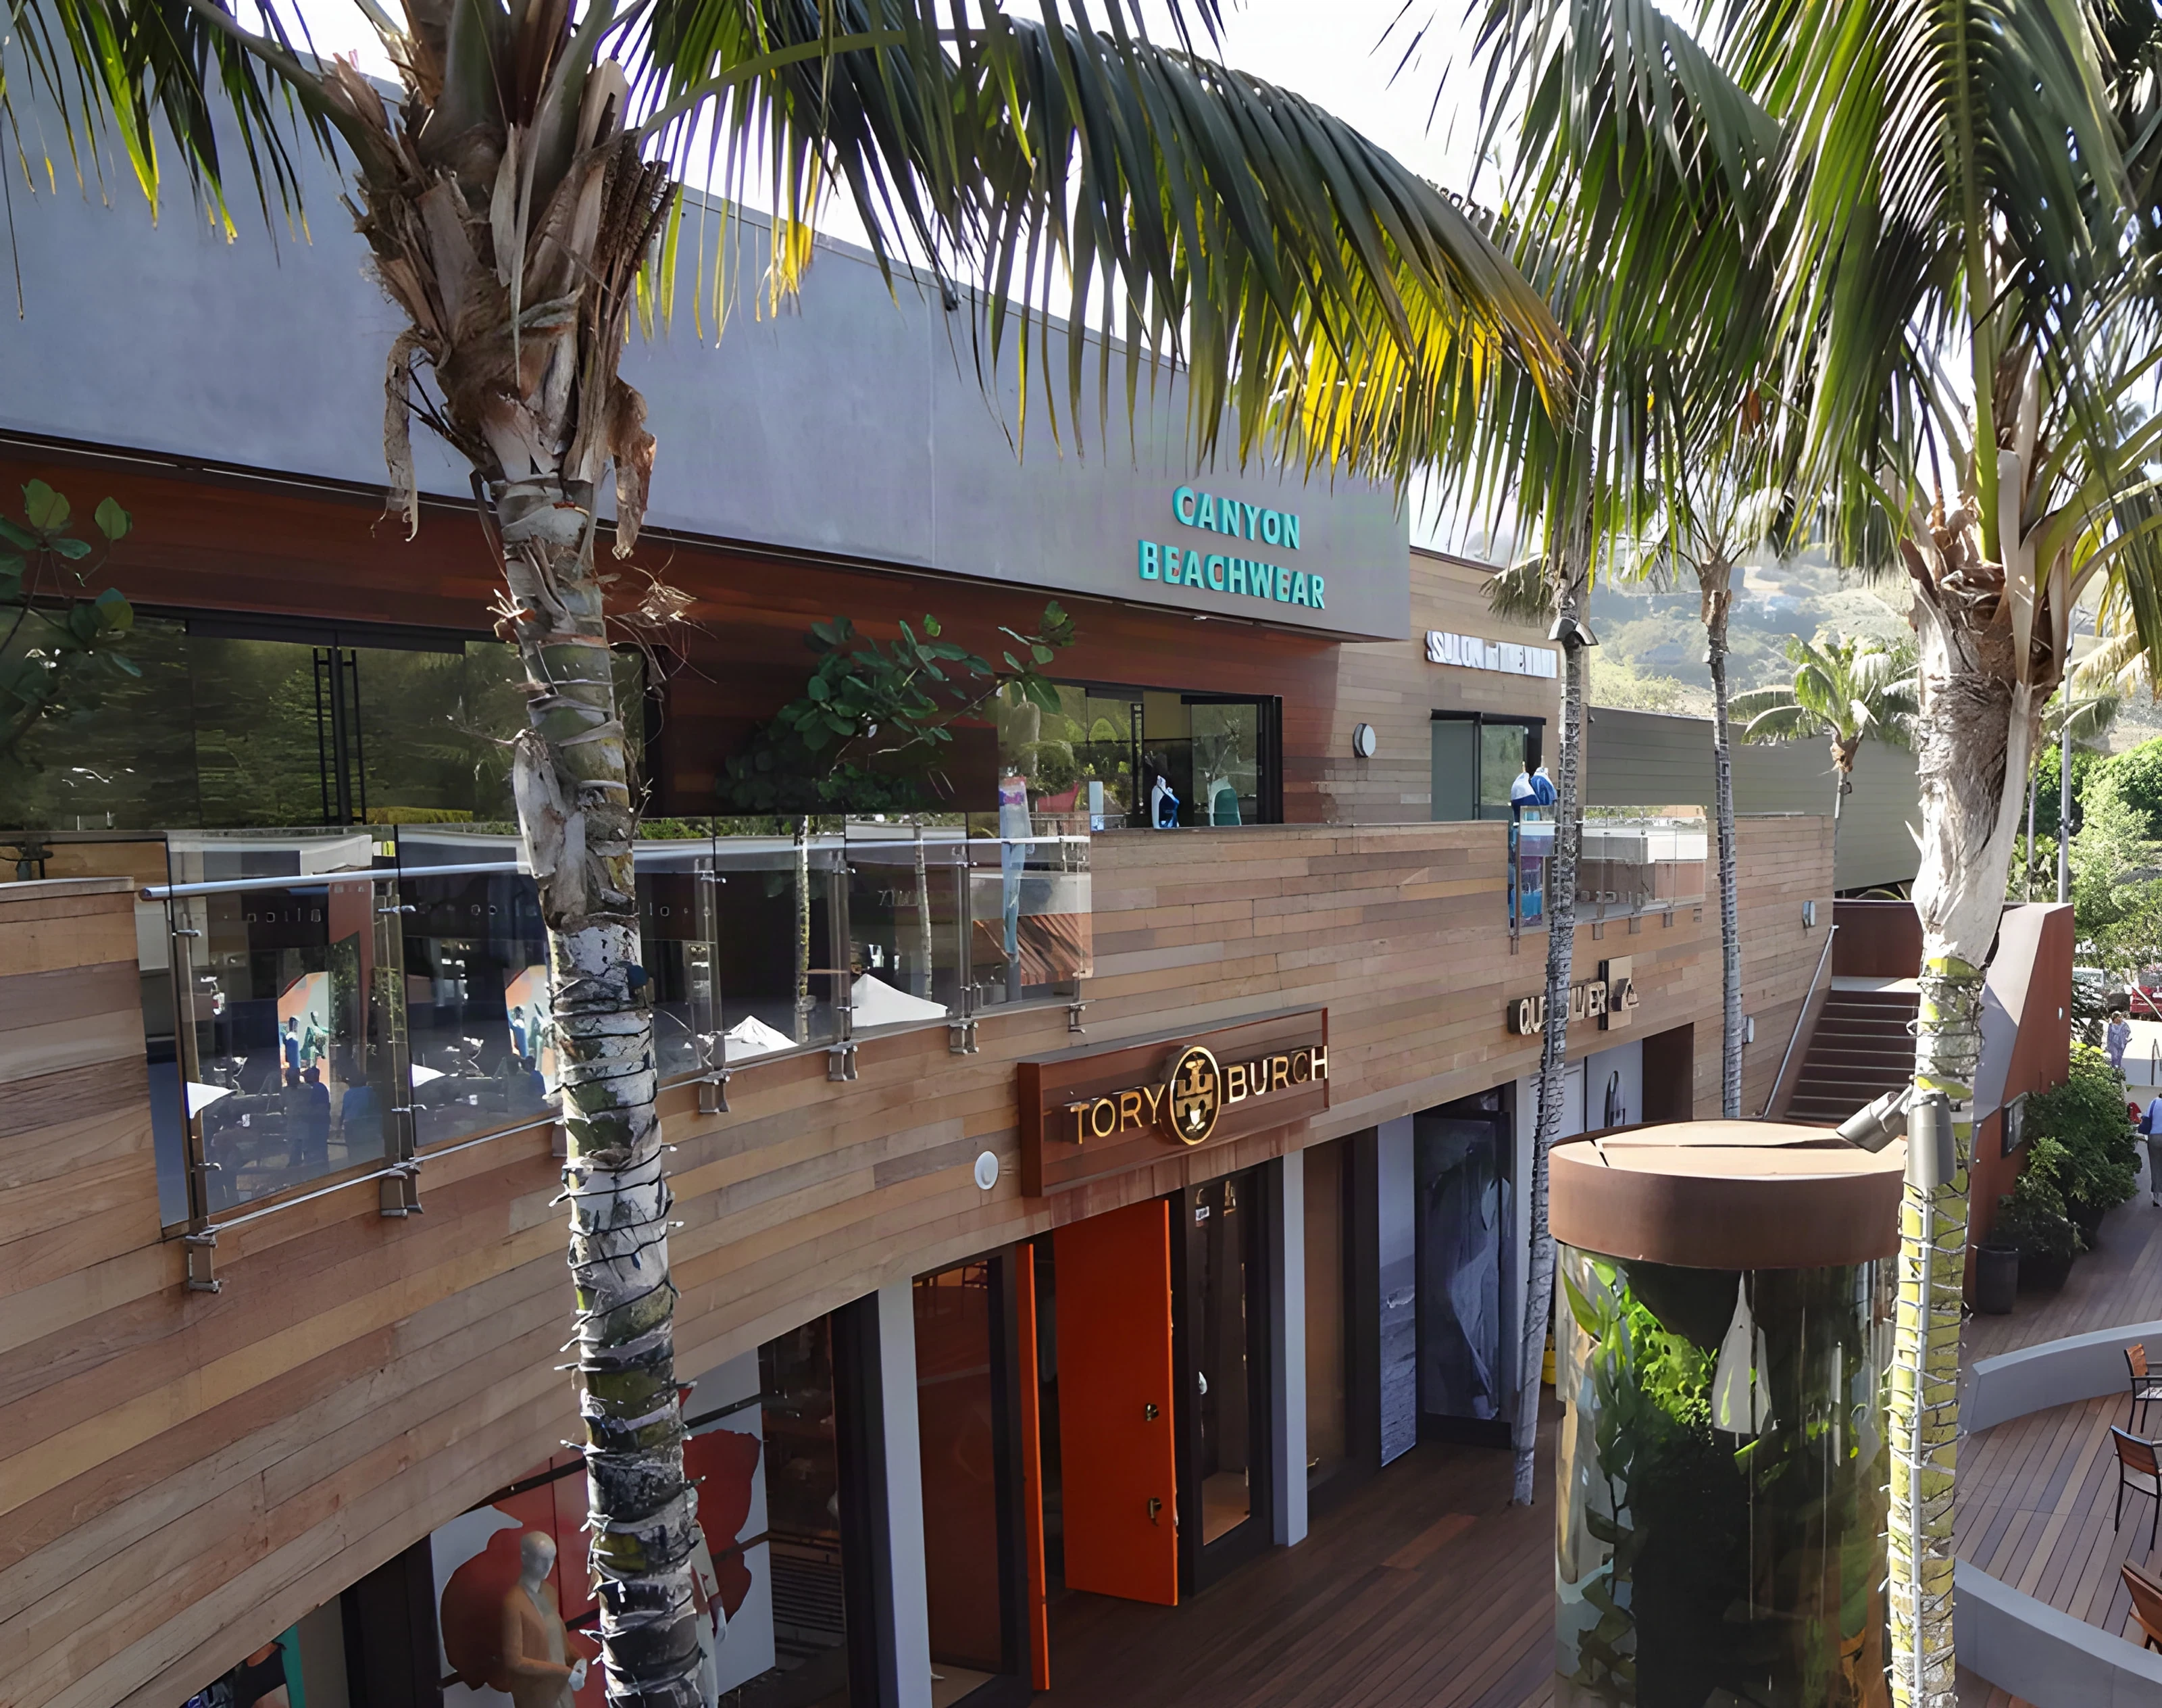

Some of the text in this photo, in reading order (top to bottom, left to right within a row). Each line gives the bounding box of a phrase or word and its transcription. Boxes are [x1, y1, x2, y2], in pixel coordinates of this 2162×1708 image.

[1172, 484, 1300, 550] CANYON
[1138, 539, 1325, 609] BEACHWEAR
[1070, 1045, 1329, 1145] TORY BURCH
